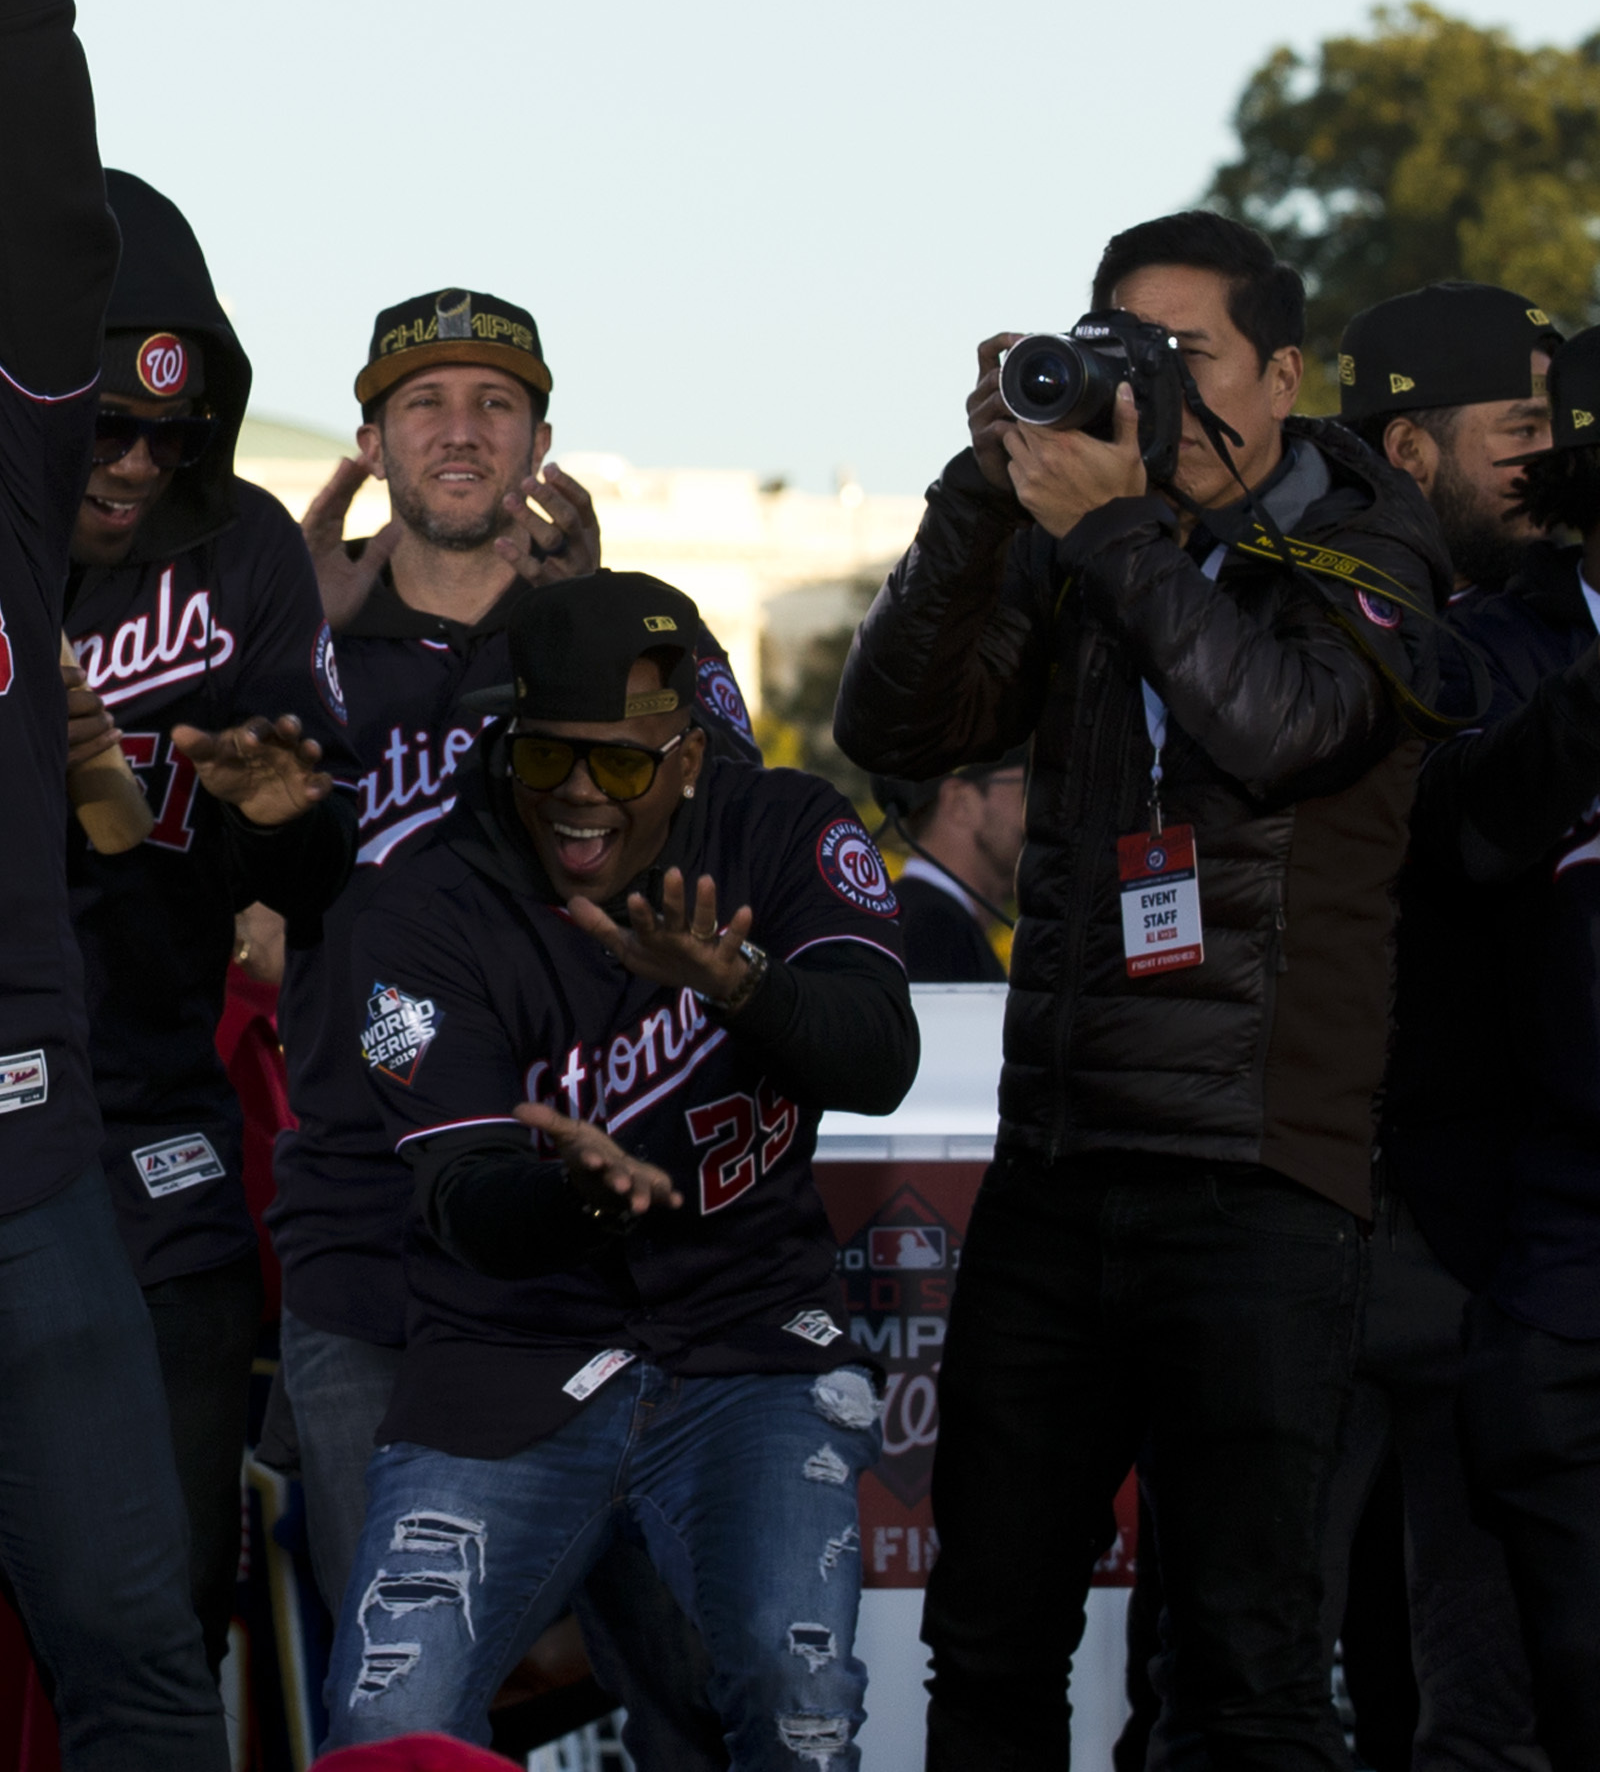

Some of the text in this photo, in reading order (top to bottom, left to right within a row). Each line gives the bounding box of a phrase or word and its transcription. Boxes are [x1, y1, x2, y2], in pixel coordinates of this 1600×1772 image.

[1075, 325, 1110, 337] Nikon
[146, 343, 184, 388] W
[1141, 889, 1178, 909] EVENT
[1144, 909, 1178, 929] STAFF
[360, 999, 436, 1050] WORLD
[367, 1019, 436, 1068] SERIES
[388, 1047, 418, 1070] 2019
[850, 1315, 947, 1359] MP
